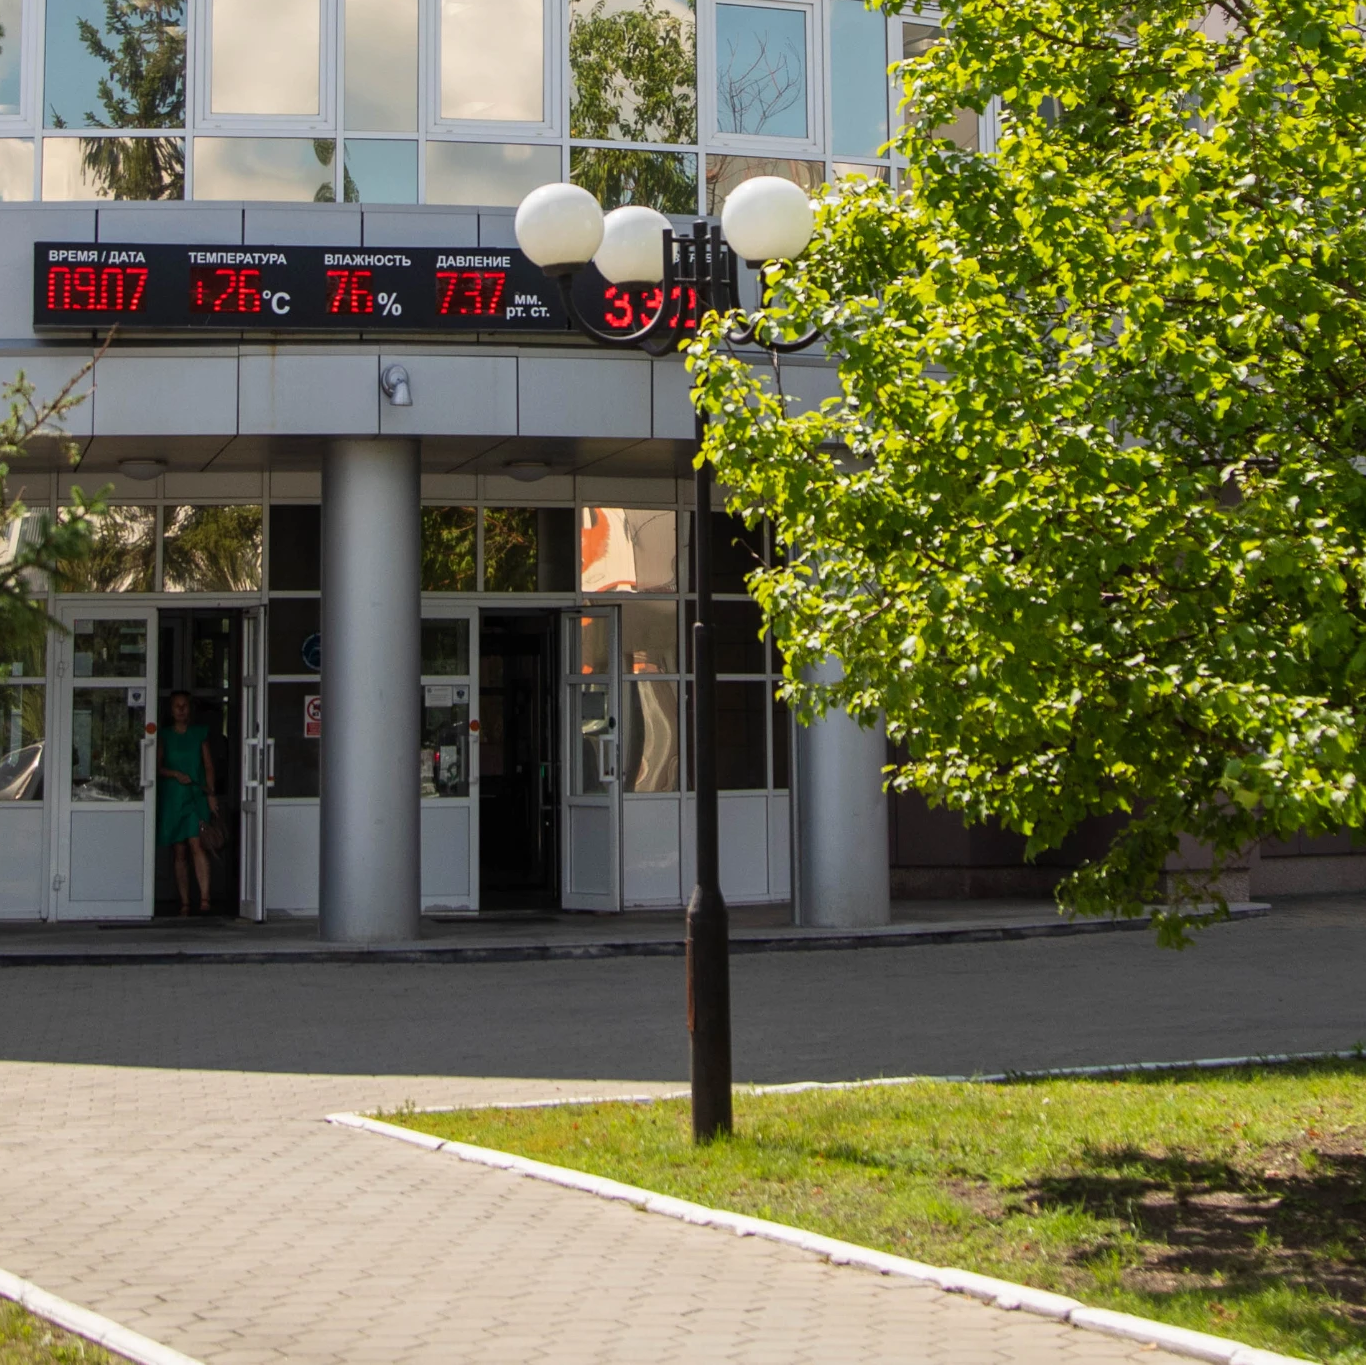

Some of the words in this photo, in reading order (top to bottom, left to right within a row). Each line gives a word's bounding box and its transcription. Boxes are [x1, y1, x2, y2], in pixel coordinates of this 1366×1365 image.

[48, 250, 98, 262] ВРЕМЯ
[108, 251, 146, 264] ДАТА
[188, 252, 287, 265] ТЕМПЕРАТУРА
[324, 253, 412, 266] ВЛАЖНОСТЬ
[436, 255, 511, 269] ДАВЛЕНИЕ
[326, 270, 374, 313] 76
[377, 292, 402, 316] %
[436, 272, 506, 314] 737
[514, 295, 542, 305] мм.
[506, 307, 526, 320] рт.
[530, 306, 550, 317] ст.
